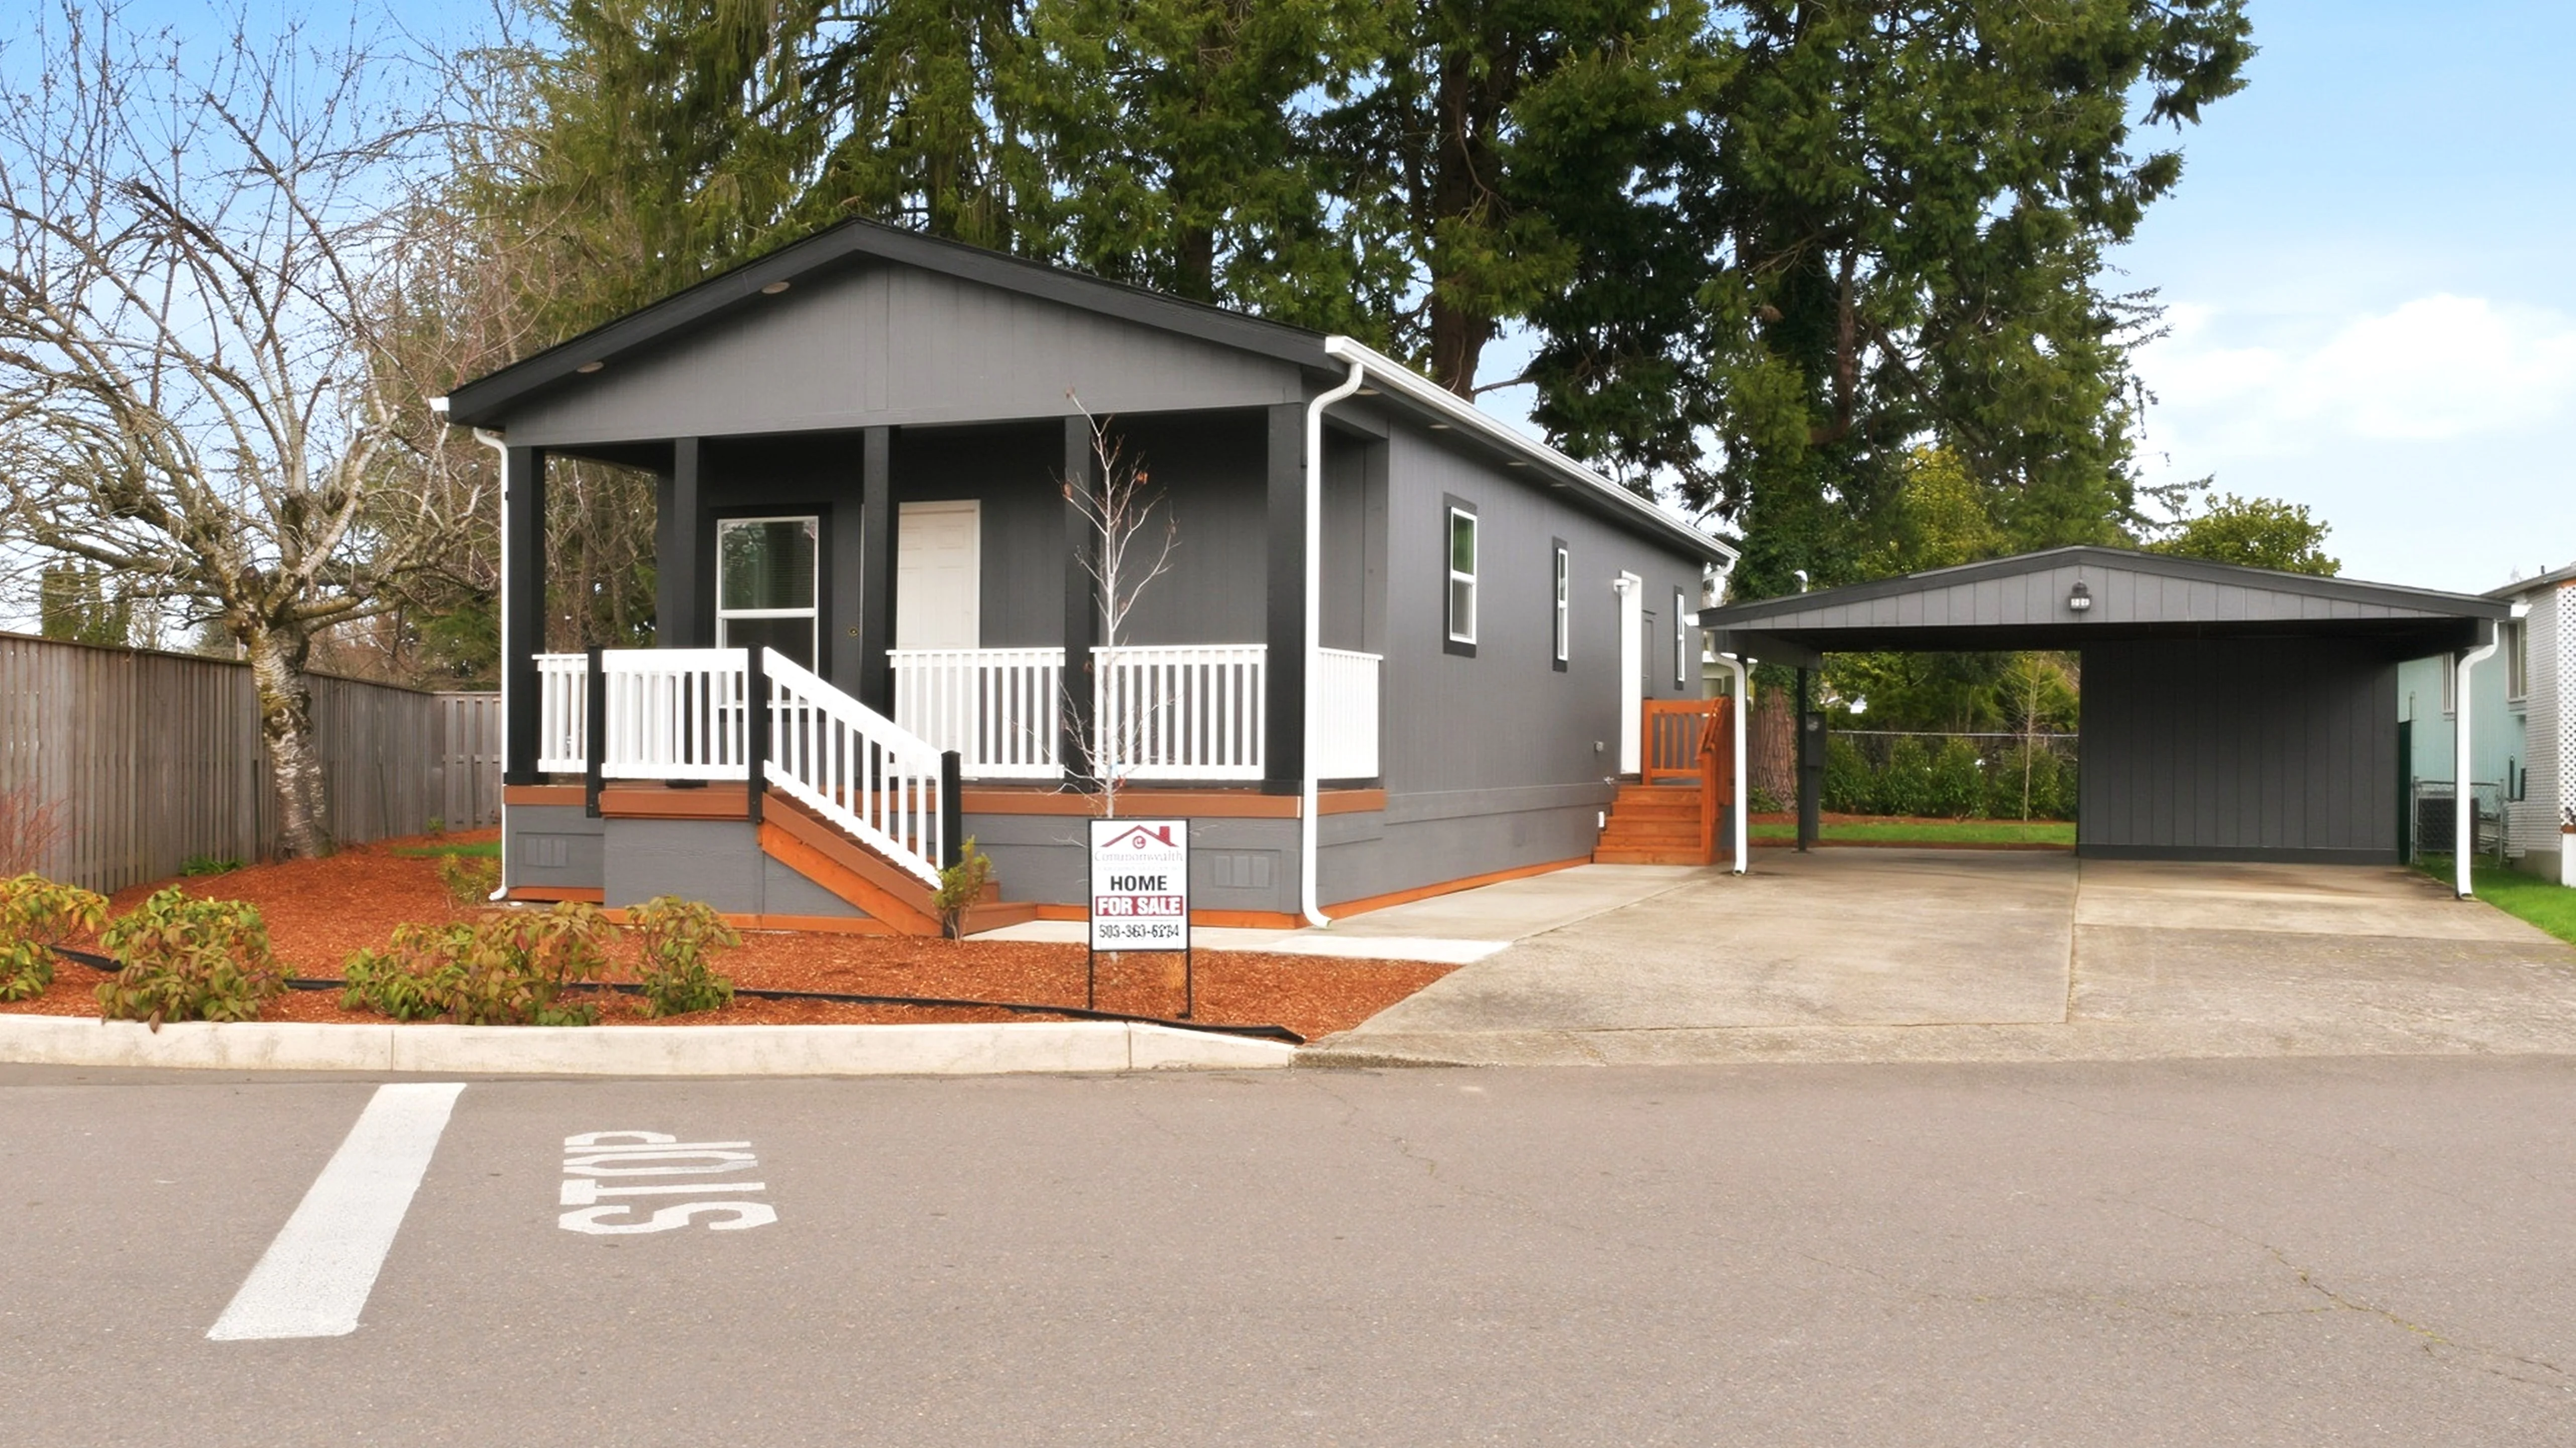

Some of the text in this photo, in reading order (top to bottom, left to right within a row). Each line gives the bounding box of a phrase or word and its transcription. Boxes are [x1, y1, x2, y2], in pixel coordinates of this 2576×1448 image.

[1094, 850, 1183, 862] Commonwealth
[1110, 875, 1167, 891] HOME
[1097, 897, 1181, 915] FOR SALE
[558, 1131, 778, 1235] STOP
